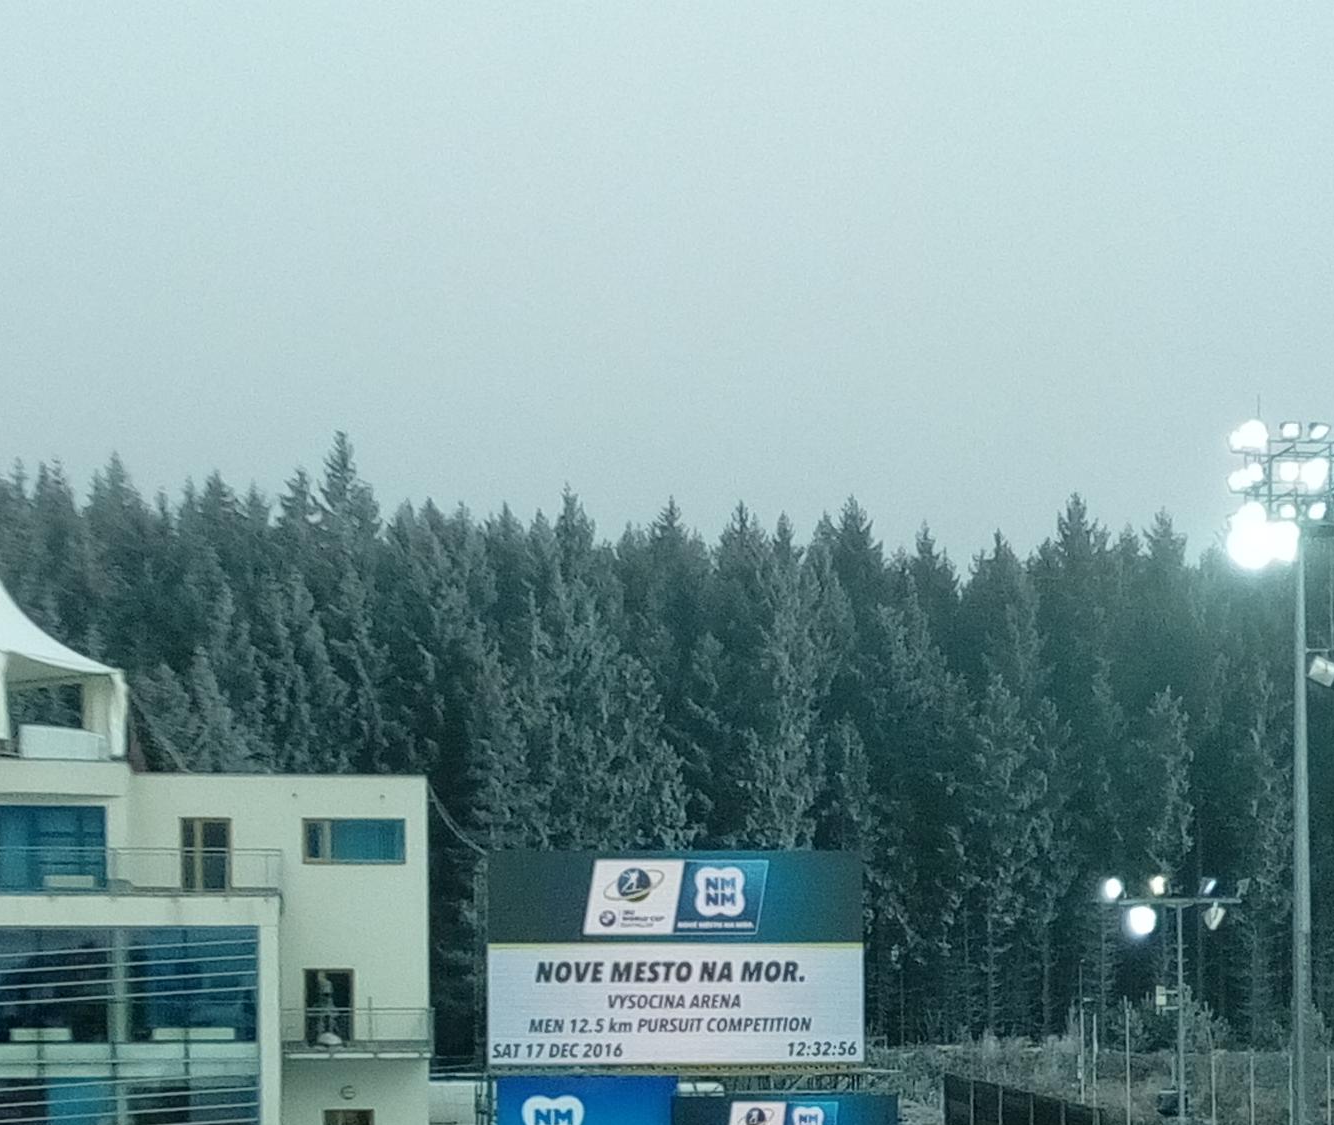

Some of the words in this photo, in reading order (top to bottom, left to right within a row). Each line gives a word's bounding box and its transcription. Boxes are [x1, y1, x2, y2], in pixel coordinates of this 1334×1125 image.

[535, 960, 604, 984] NOVE
[609, 960, 692, 984] MESTO
[698, 960, 733, 983] NA
[740, 960, 806, 984] MOR.
[608, 994, 685, 1010] VYSOCINA
[689, 994, 742, 1010] ARENA
[528, 1018, 564, 1034] MEN
[569, 1018, 605, 1034] 12.5
[608, 1016, 633, 1034] km
[636, 1018, 704, 1033] PURSUIT
[706, 1017, 812, 1034] COMPETITION
[492, 1043, 521, 1059] SAT
[525, 1043, 545, 1059] 17
[548, 1043, 579, 1059] DEC
[583, 1042, 624, 1058] 2016
[786, 1041, 858, 1058] 12:32:56
[534, 1108, 574, 1125] NM
